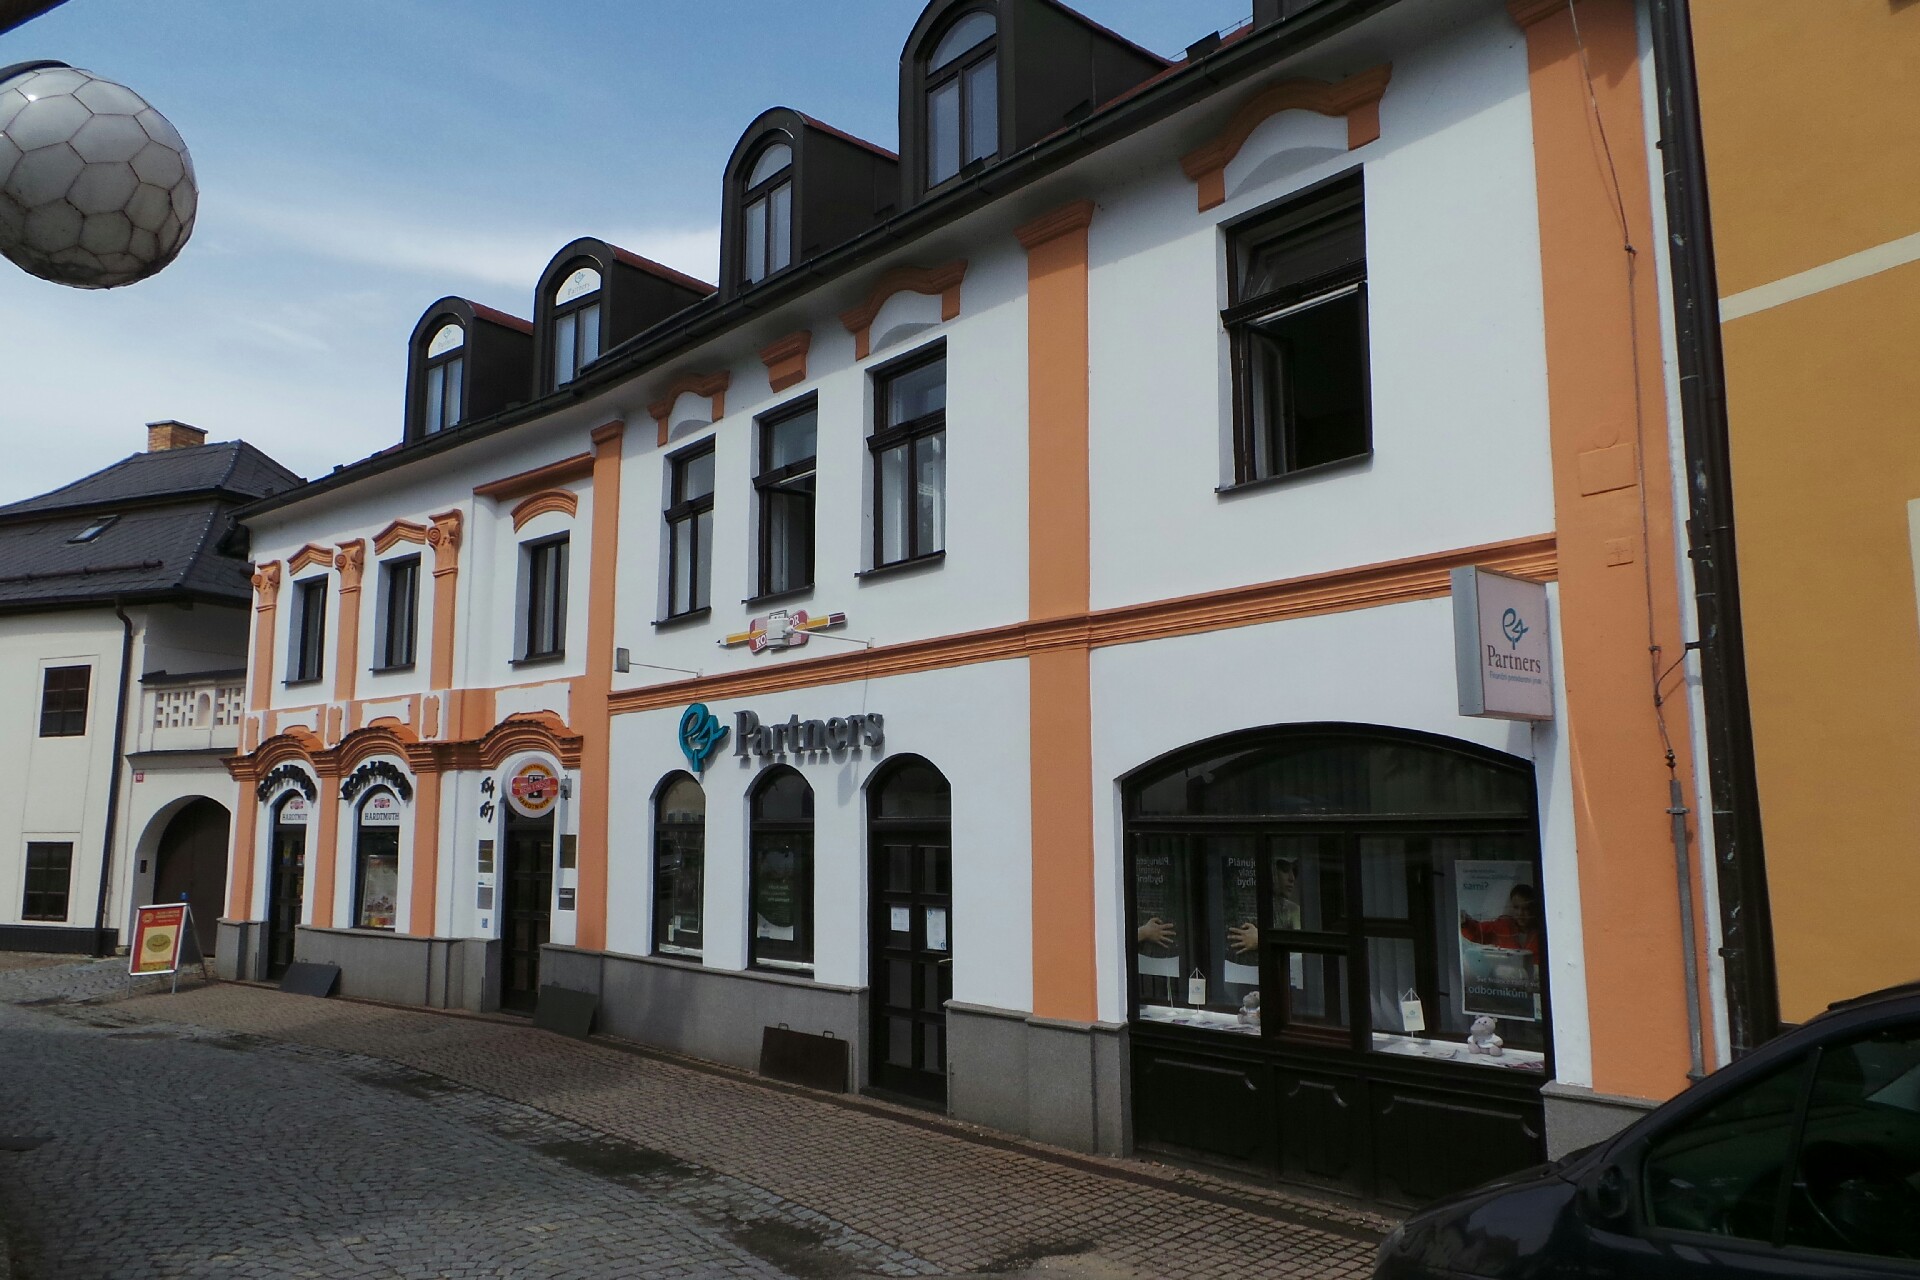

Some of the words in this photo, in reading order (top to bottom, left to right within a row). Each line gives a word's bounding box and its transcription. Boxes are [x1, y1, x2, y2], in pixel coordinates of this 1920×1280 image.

[1487, 644, 1542, 674] Partners
[733, 710, 885, 757] Partners
[364, 812, 400, 821] HARDTMUTH
[1463, 881, 1489, 890] sami?
